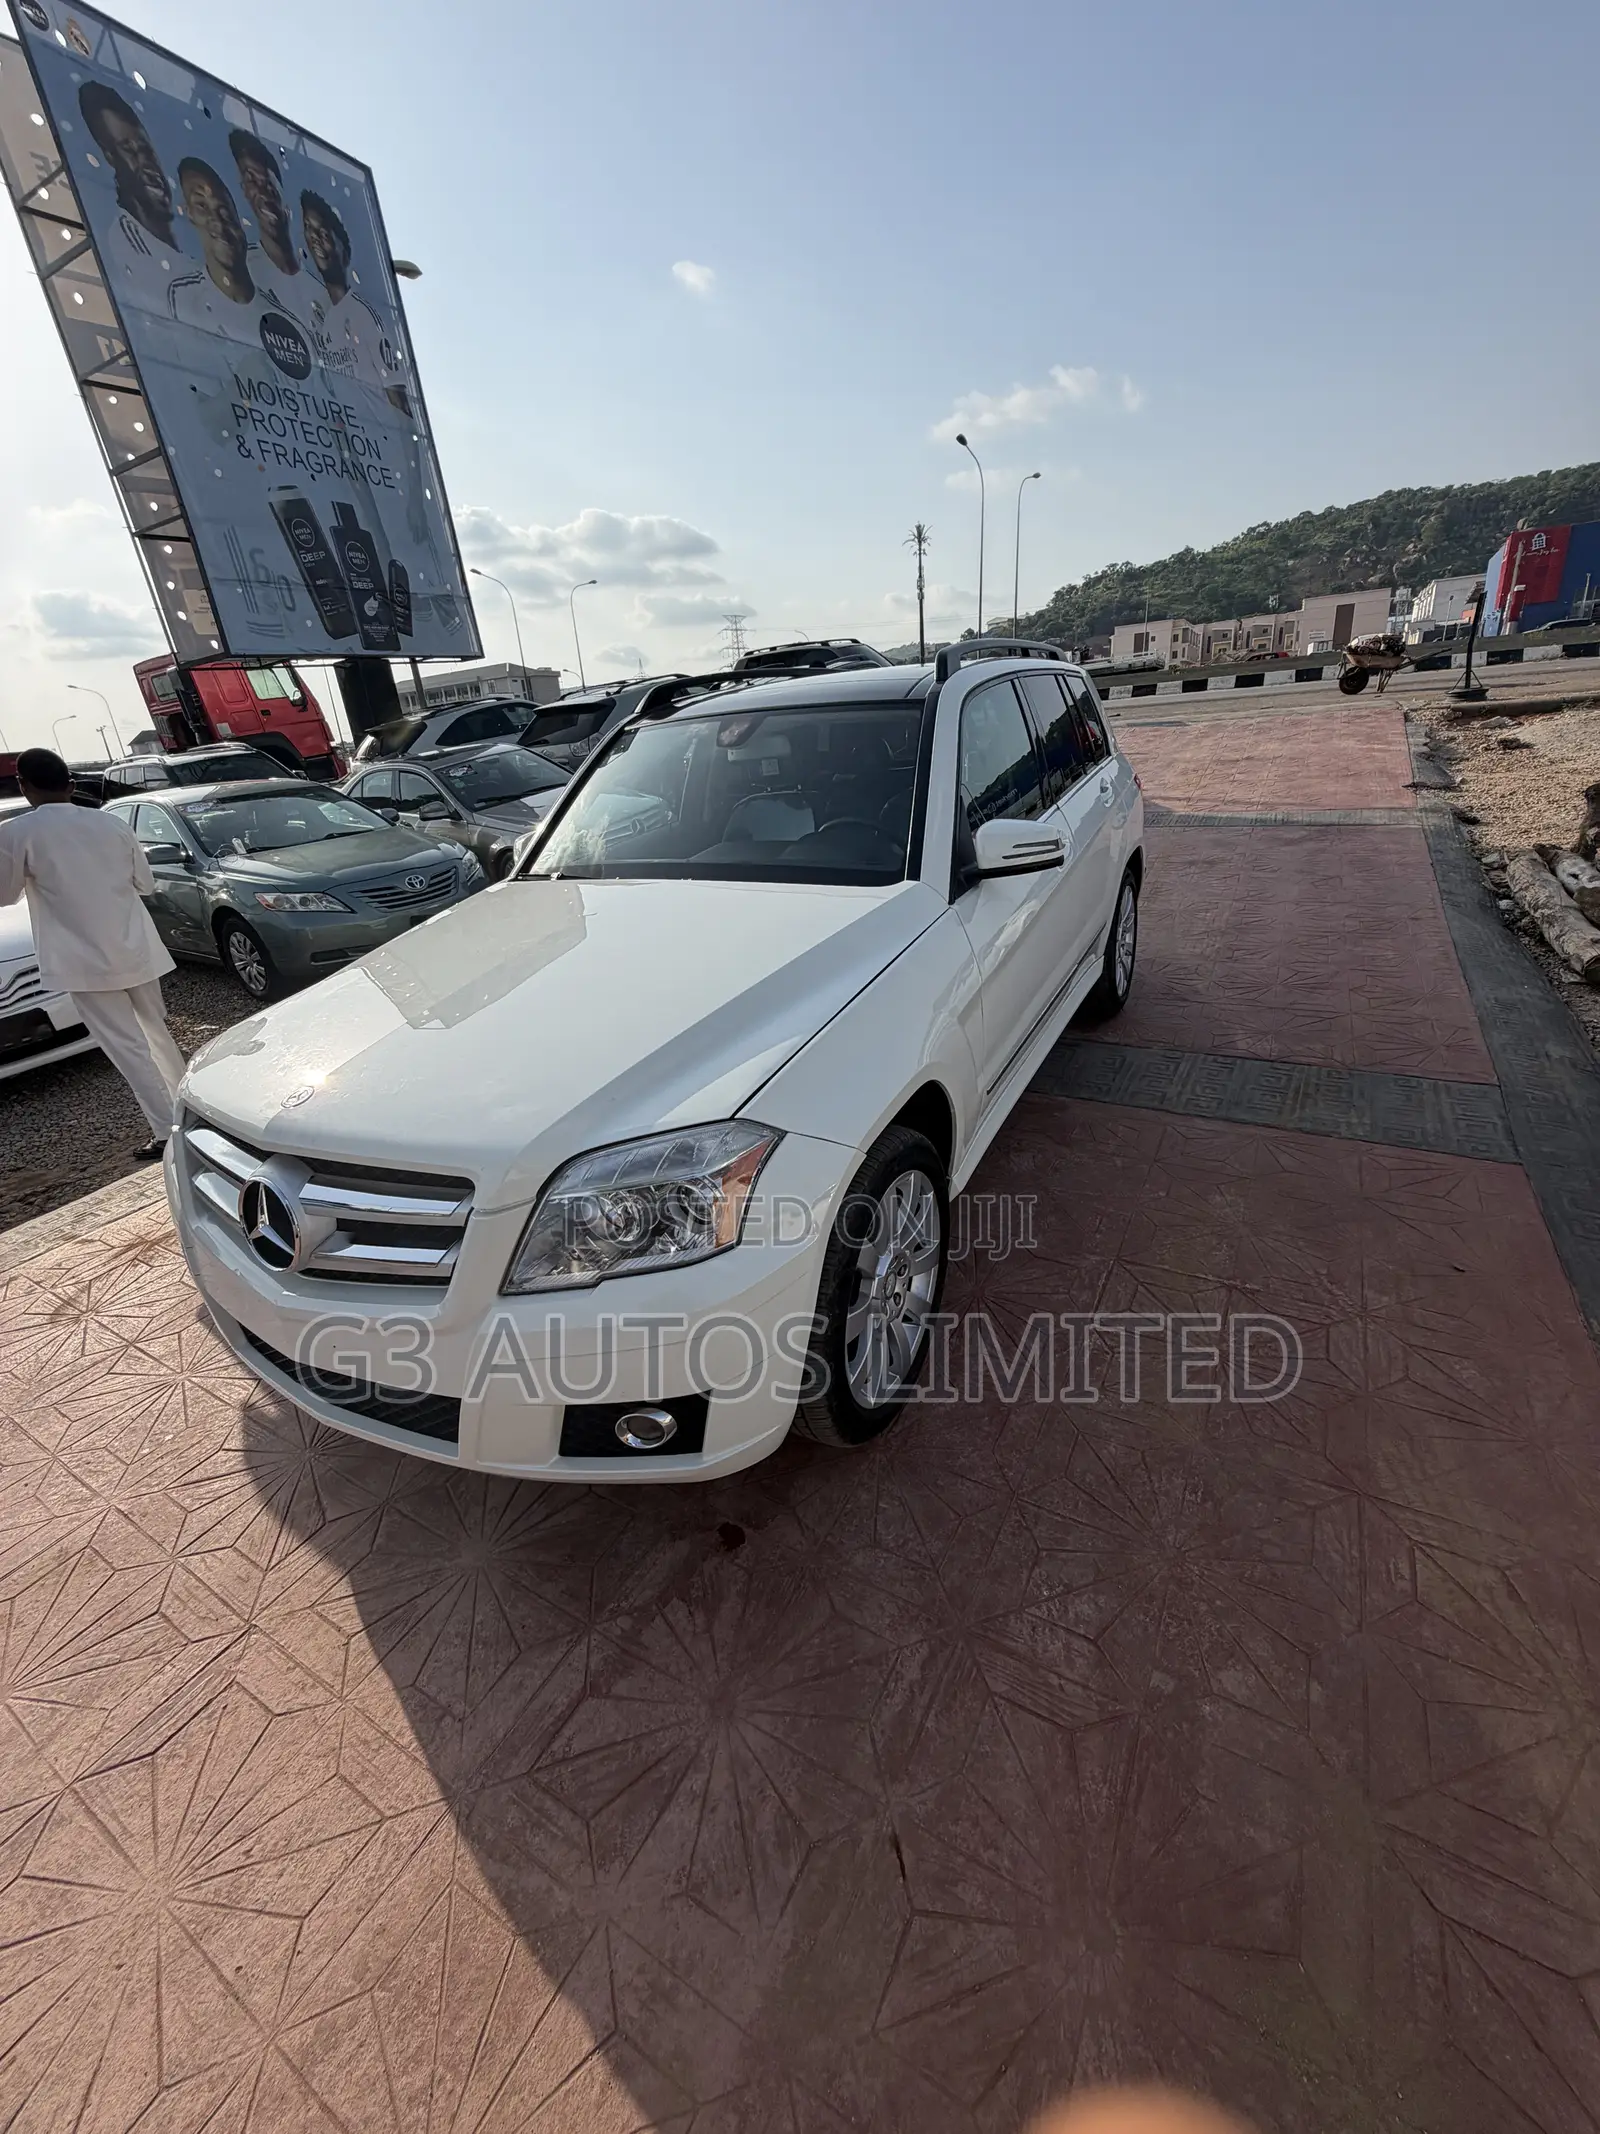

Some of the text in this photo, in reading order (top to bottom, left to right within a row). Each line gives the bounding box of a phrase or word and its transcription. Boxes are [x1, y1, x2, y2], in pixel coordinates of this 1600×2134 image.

[264, 331, 306, 356] NIVEA
[274, 348, 304, 367] MEN
[234, 374, 366, 434] MOISTURE,
[231, 402, 382, 461] PROTECTION
[236, 434, 396, 489] & FRAGRANCE
[300, 551, 326, 563] DEEP
[352, 581, 374, 590] DEEP
